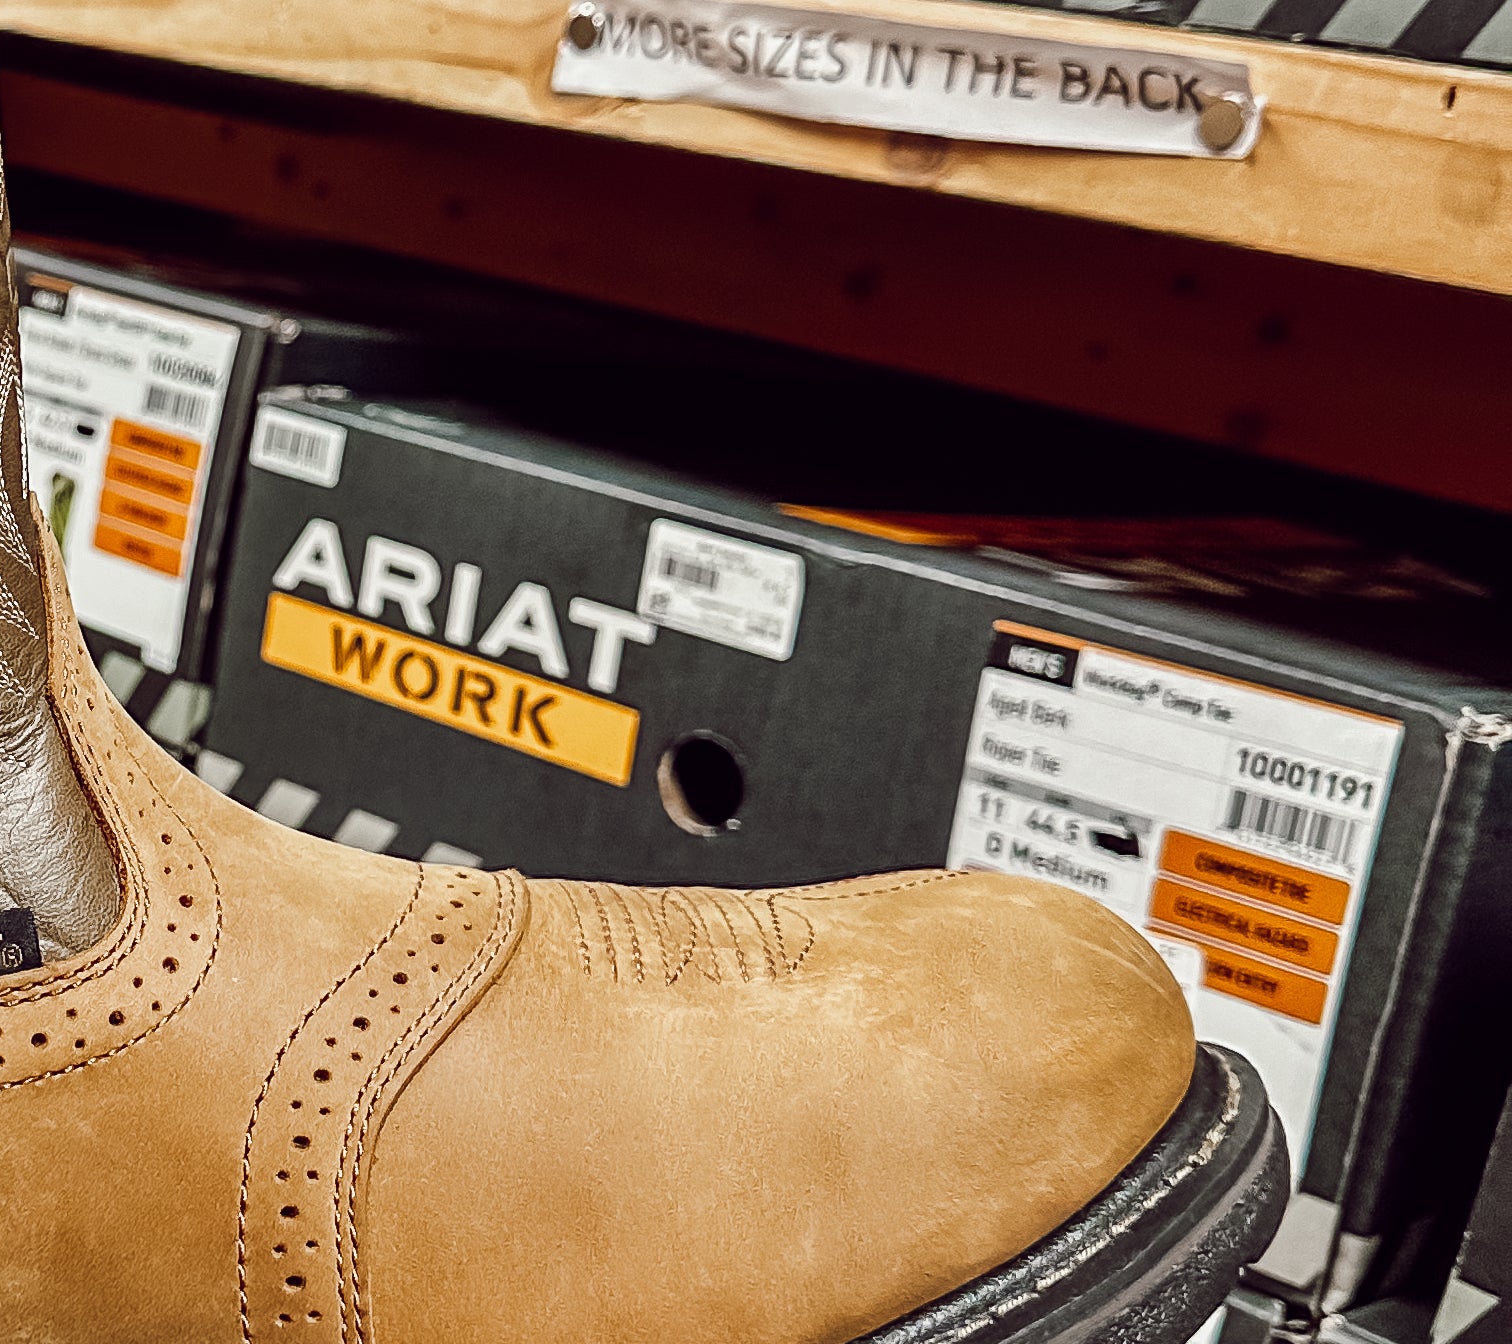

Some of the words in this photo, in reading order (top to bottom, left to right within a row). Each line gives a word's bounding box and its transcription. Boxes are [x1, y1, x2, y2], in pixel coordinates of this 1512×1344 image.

[597, 11, 717, 67] MORE
[725, 23, 849, 83] SIZES
[864, 37, 919, 88] IN
[936, 43, 1037, 100] THE
[1058, 59, 1203, 114] BACK
[271, 517, 657, 694] ARIAT
[330, 622, 561, 751] WORK
[1236, 747, 1376, 810] 10001191
[1010, 837, 1112, 893] Medium
